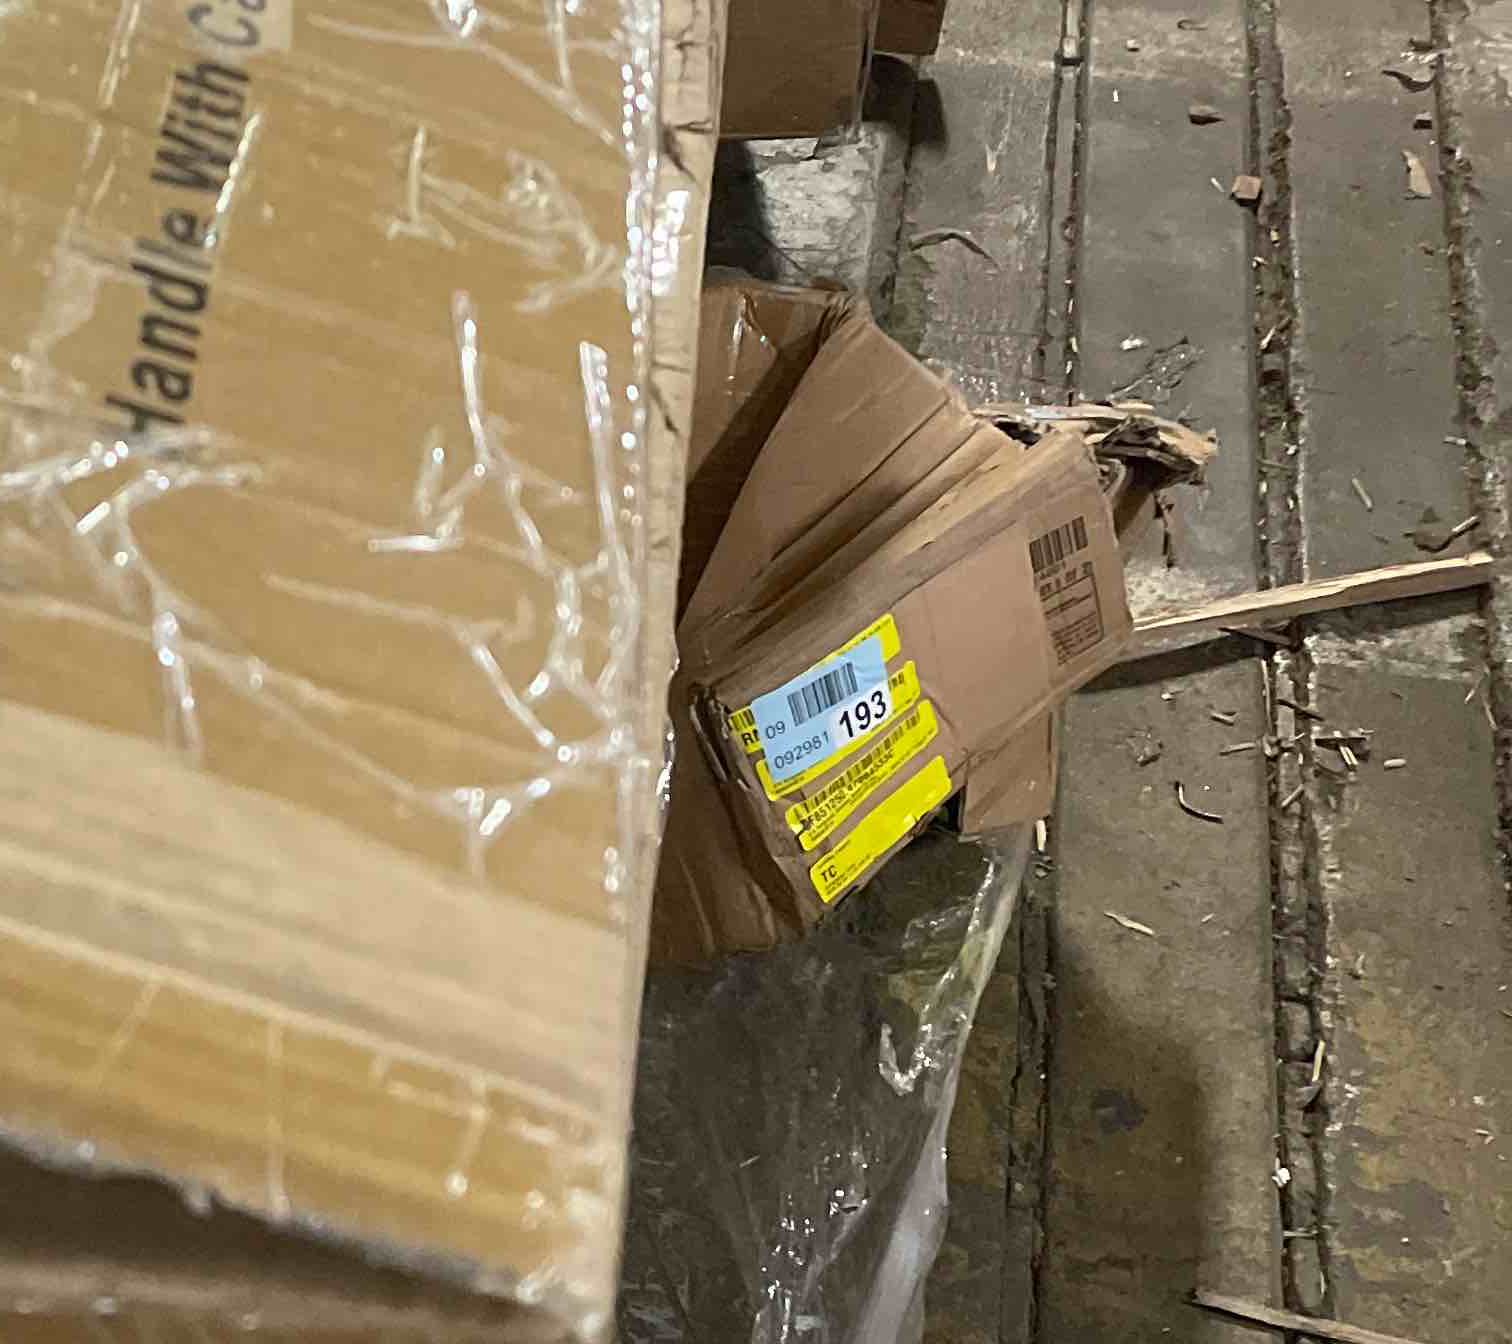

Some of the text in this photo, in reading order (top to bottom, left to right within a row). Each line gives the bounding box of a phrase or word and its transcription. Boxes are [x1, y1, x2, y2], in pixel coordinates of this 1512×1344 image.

[151, 59, 252, 198] With
[105, 207, 215, 458] Handle
[766, 721, 786, 740] 09
[774, 731, 830, 769] 092981
[839, 690, 887, 738] 193
